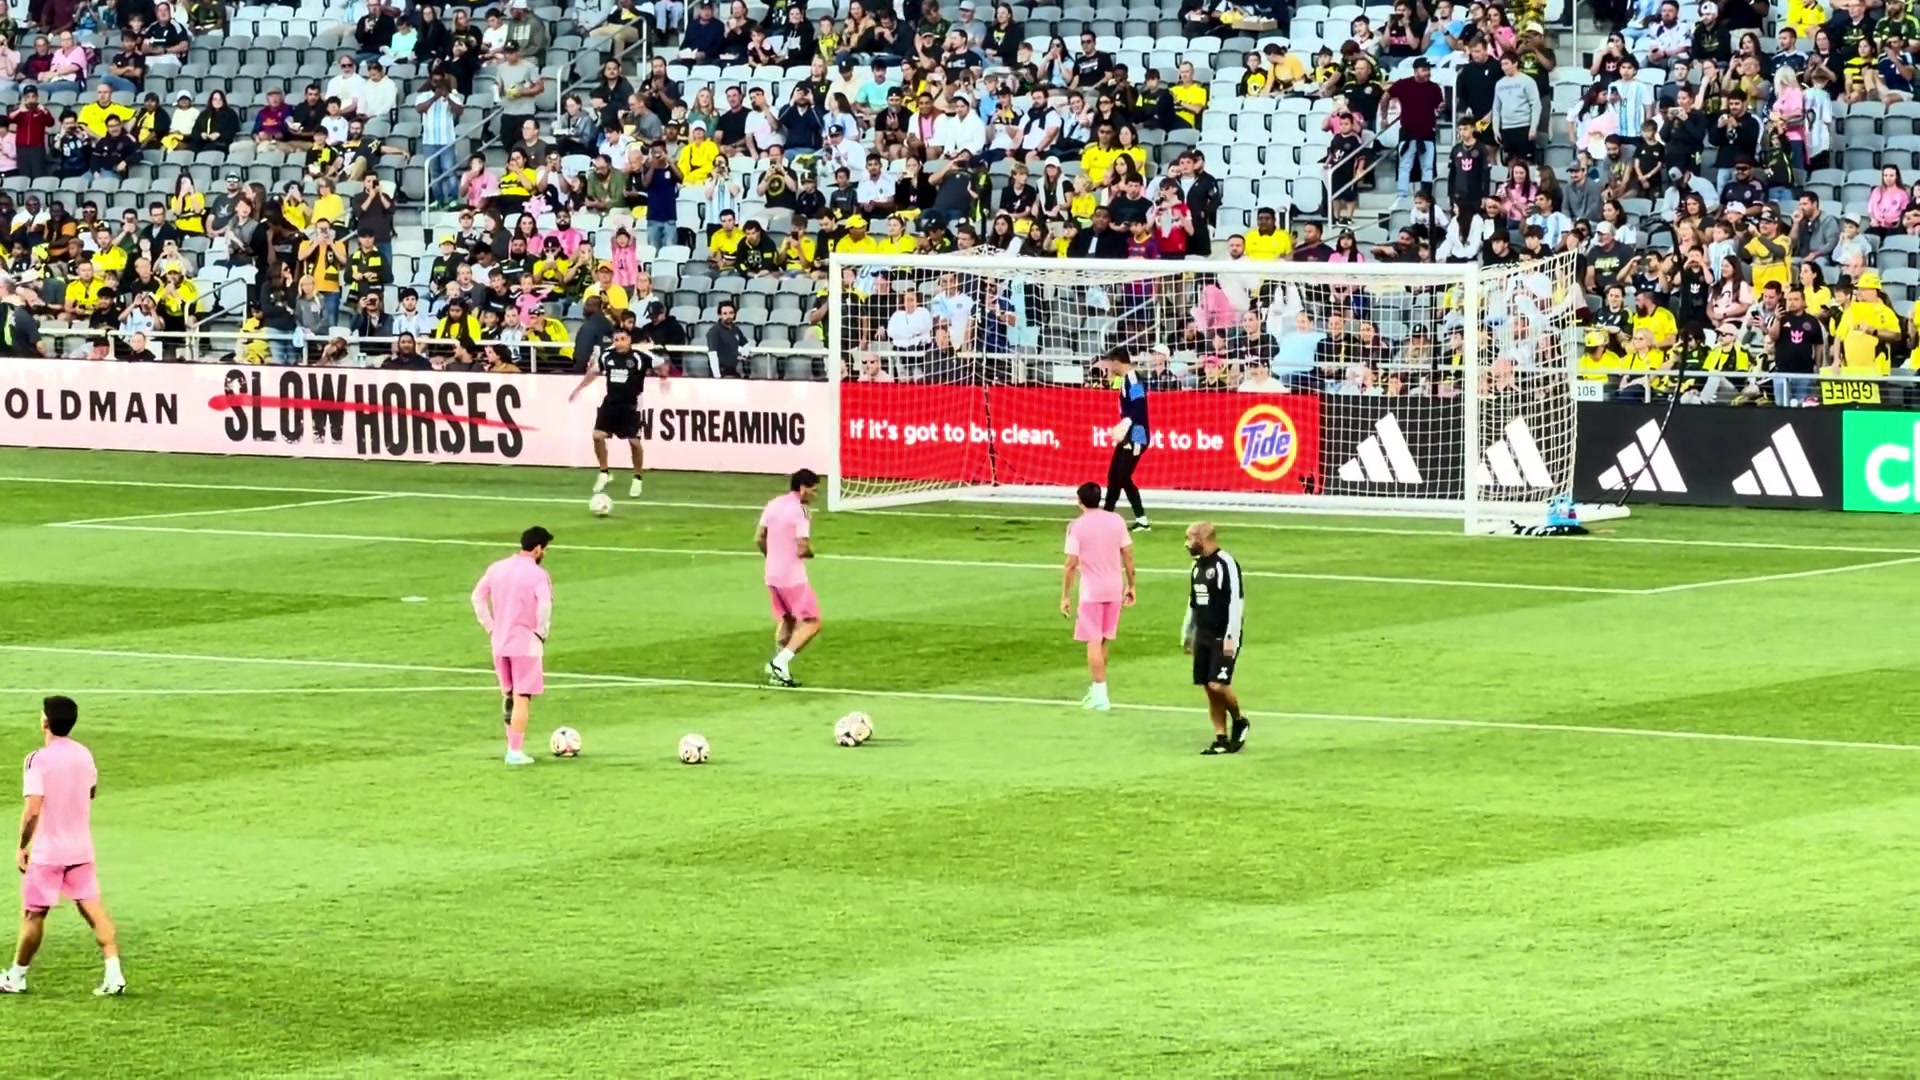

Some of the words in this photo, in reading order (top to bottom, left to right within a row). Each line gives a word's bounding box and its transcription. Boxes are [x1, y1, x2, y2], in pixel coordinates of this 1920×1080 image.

[4, 387, 178, 425] OLDMAN
[1577, 385, 1597, 397] 106
[1825, 381, 1873, 400] GRIEF
[224, 369, 348, 444] SLOW
[354, 382, 523, 458] HORSES
[659, 408, 805, 446] STREAMING
[849, 419, 865, 439] If
[869, 419, 898, 440] it's
[903, 422, 938, 445] got
[943, 422, 965, 442] to
[1001, 423, 1060, 448] clean,
[1092, 425, 1118, 447] it'
[1169, 429, 1192, 449] to
[1196, 428, 1224, 450] be
[1240, 421, 1292, 468] Tide
